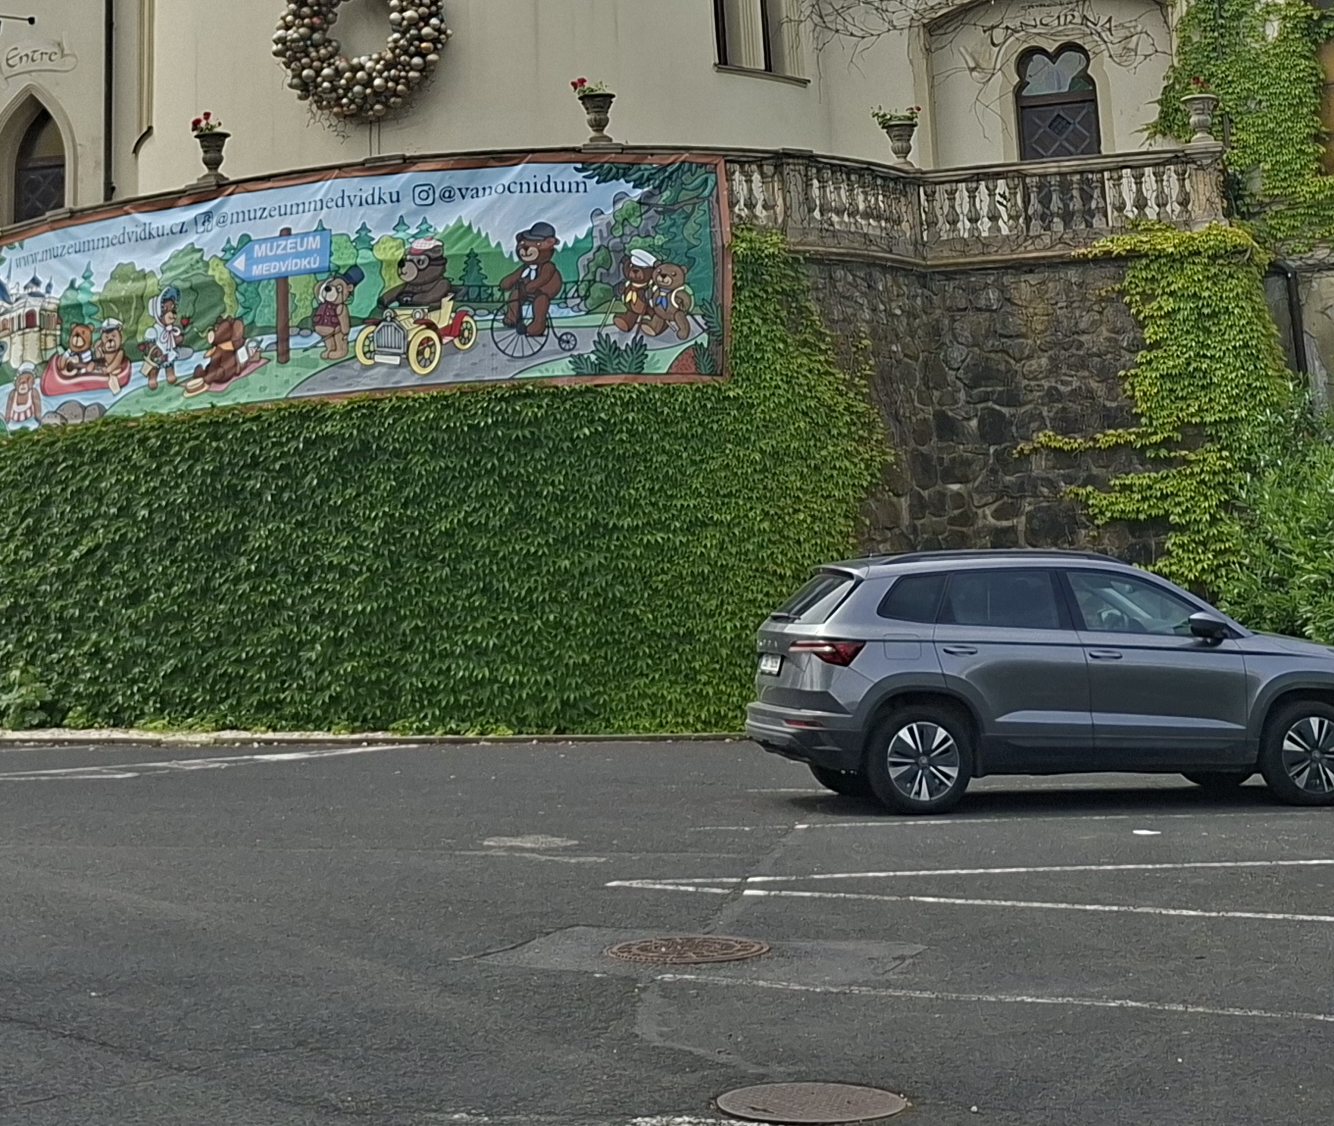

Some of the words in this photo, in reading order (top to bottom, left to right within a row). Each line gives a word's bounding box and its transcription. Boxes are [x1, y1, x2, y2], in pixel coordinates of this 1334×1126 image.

[15, 221, 188, 269] www.muzeummedvidku.cz
[217, 187, 401, 227] @muzeummedvidku
[439, 174, 588, 203] @vanocnidum
[254, 235, 321, 258] MUZEUM
